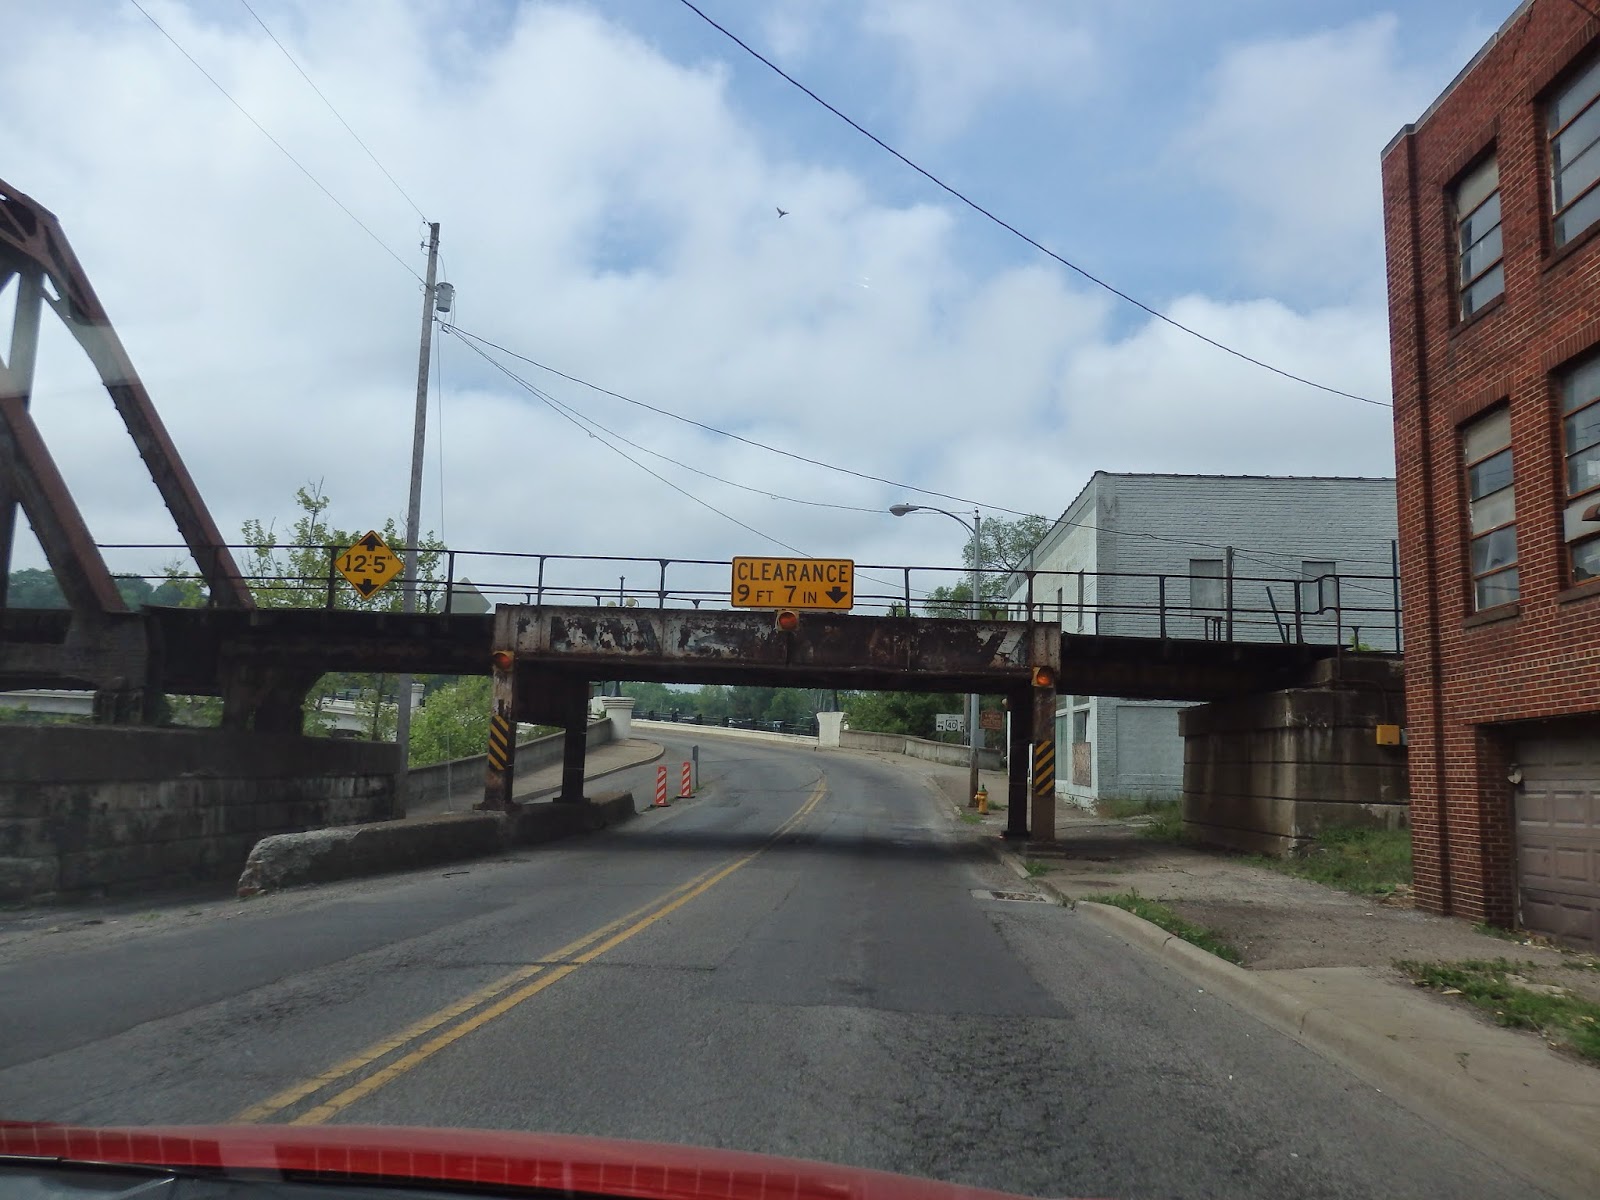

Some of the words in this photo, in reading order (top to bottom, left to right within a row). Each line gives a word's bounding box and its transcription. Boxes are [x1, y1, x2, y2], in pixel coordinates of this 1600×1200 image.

[737, 562, 848, 583] CLEARANCE
[737, 584, 750, 602] 9
[756, 590, 774, 603] FT
[783, 585, 797, 603] 7
[803, 591, 817, 603] IN
